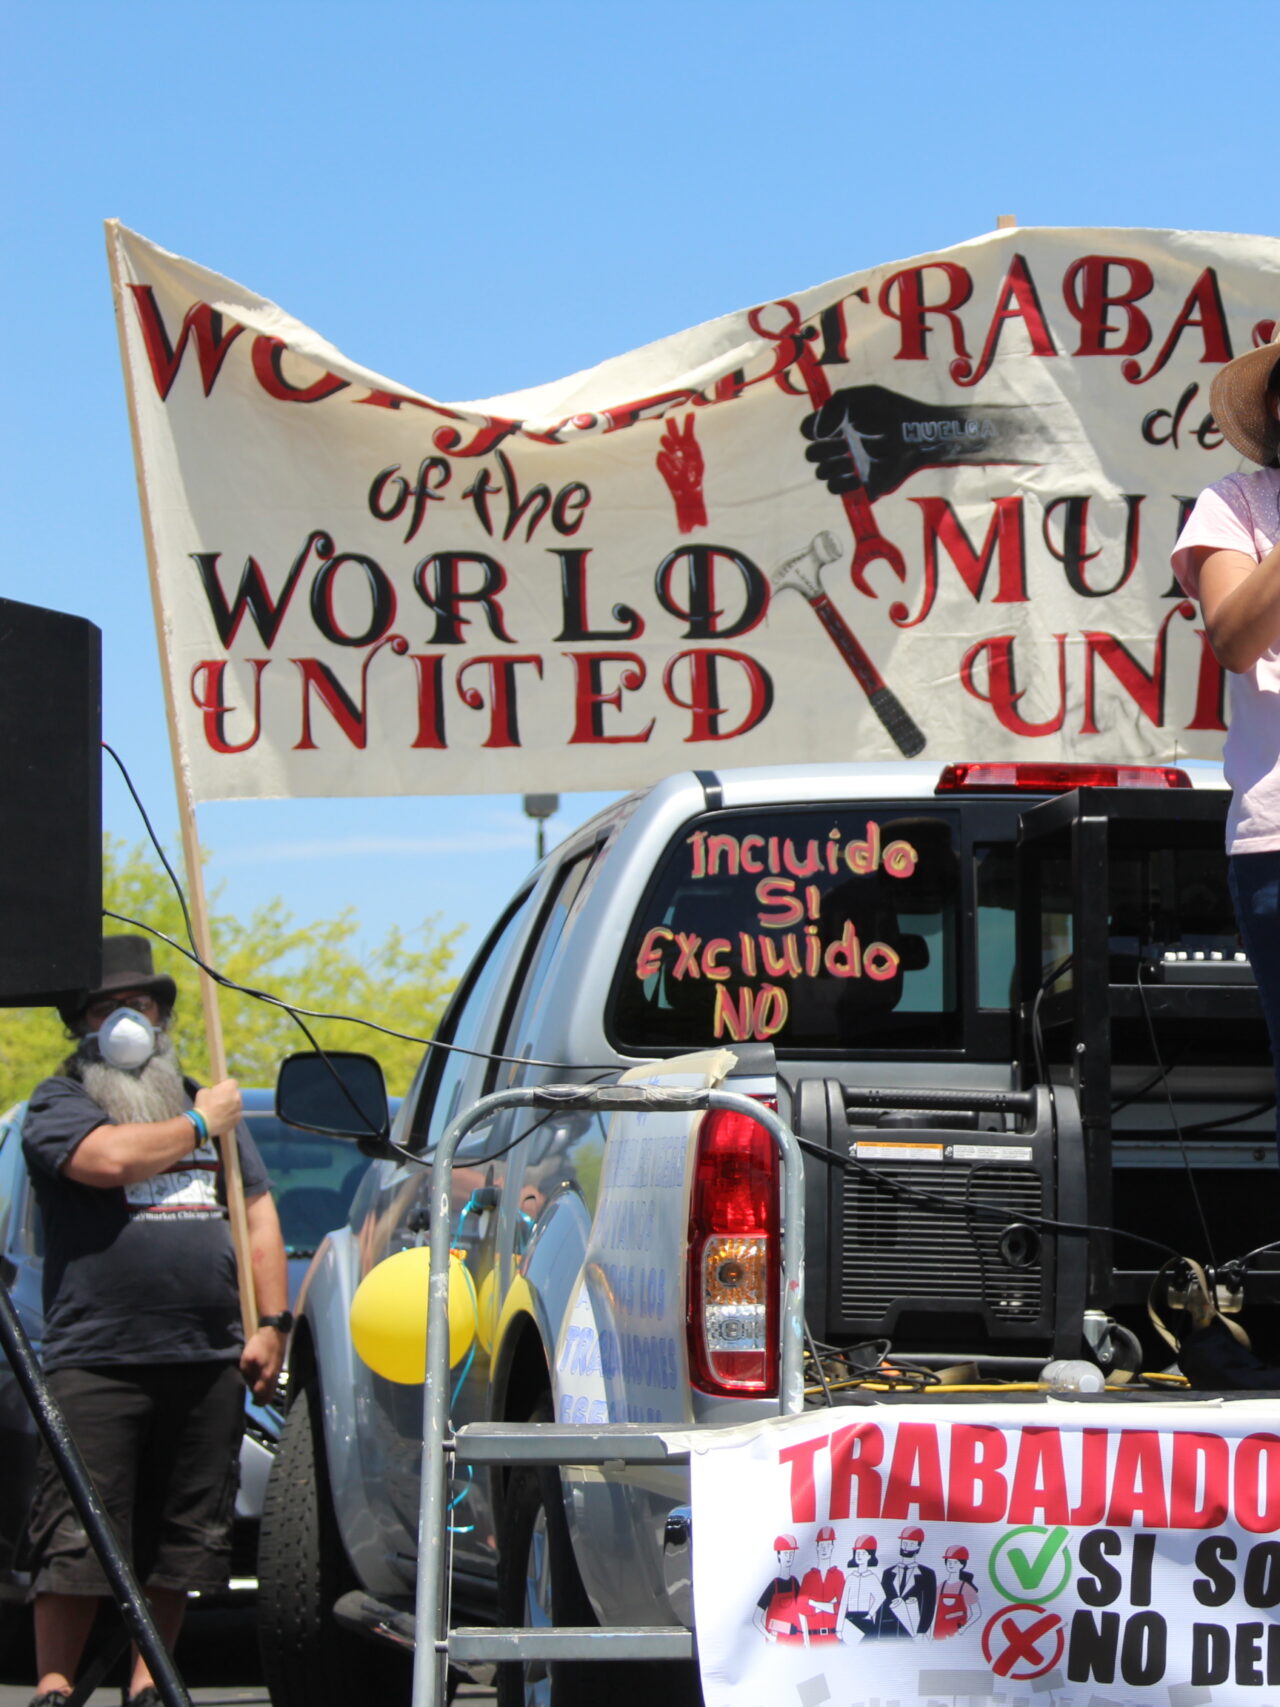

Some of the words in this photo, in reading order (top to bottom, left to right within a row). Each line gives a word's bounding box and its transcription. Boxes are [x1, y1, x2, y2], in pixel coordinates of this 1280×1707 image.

[901, 419, 999, 443] HUELGA
[368, 454, 451, 543] of
[462, 449, 592, 543] the
[190, 529, 771, 650] WORLD
[191, 634, 775, 754] UNITED
[714, 982, 789, 1041] NO
[1076, 1528, 1157, 1608] SI
[1066, 1609, 1167, 1686] NO
